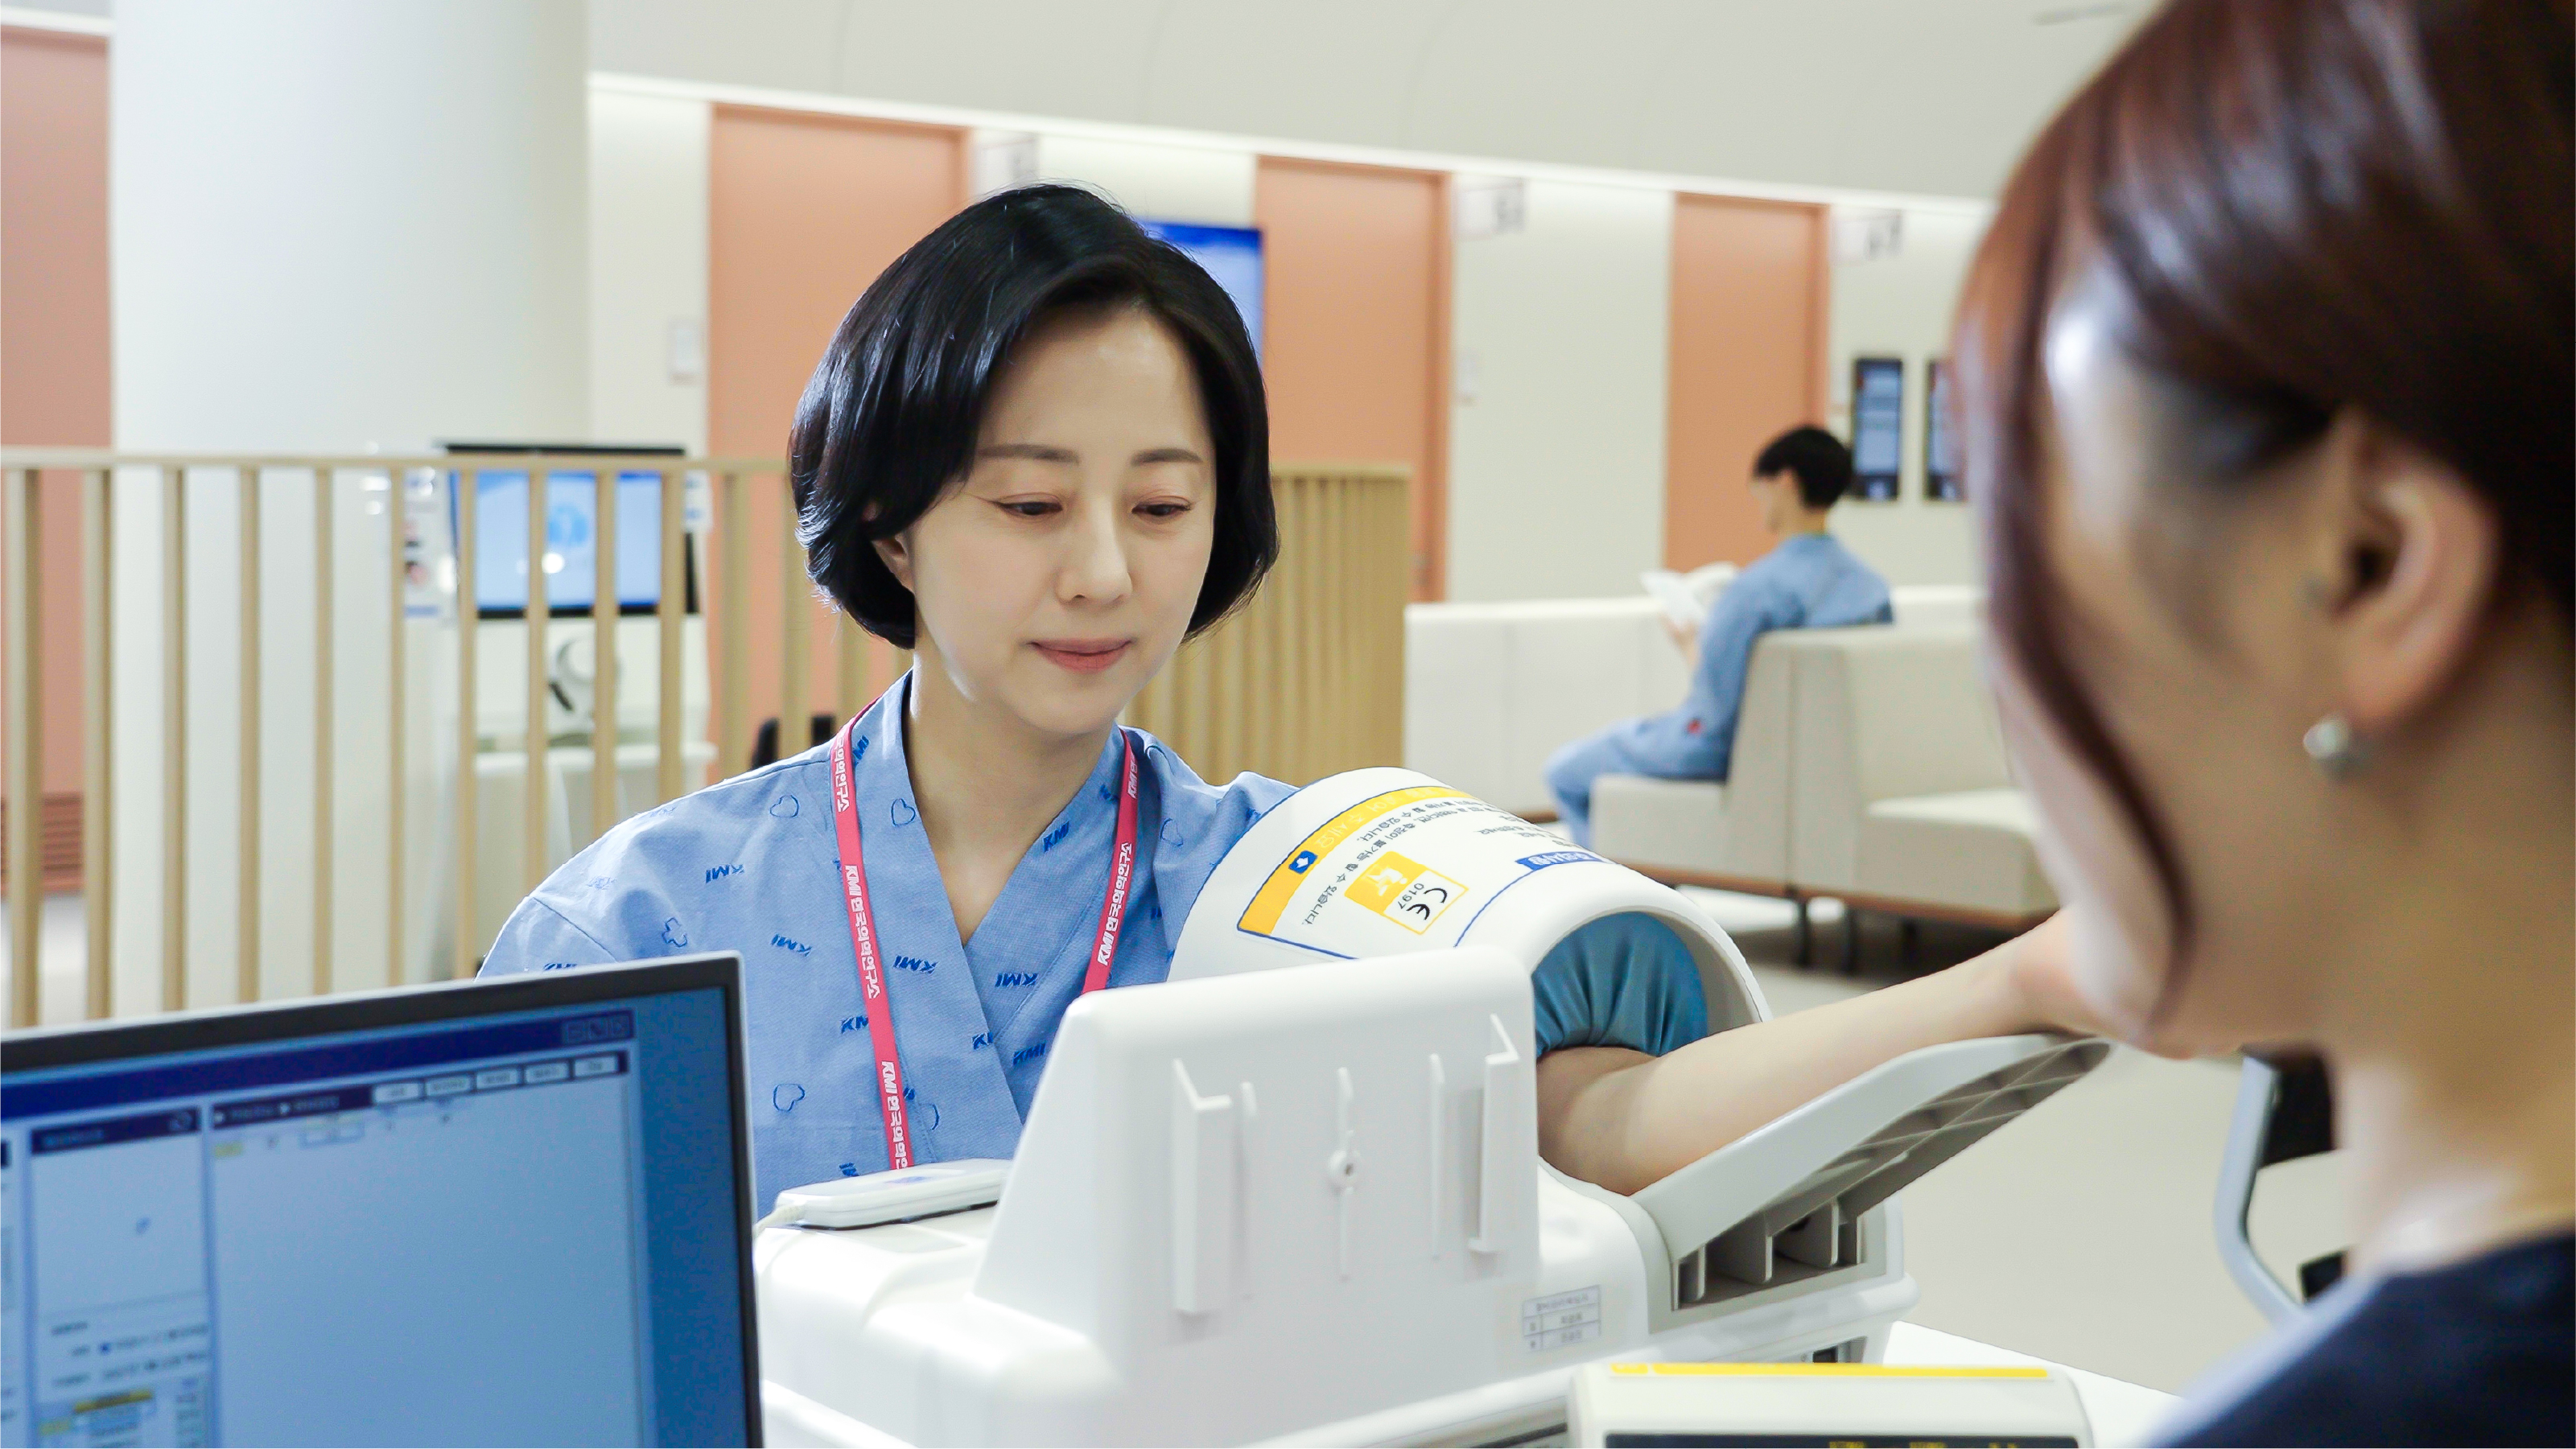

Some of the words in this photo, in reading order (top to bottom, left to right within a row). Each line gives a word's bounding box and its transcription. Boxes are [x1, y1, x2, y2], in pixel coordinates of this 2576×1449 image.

[835, 735, 850, 813] 국의학연구소
[1043, 821, 1070, 853] KMI
[1357, 817, 1401, 842] 있습니다.
[1384, 823, 1416, 840] 측정이
[1356, 839, 1387, 862] 불가능
[705, 864, 744, 884] KMI
[1336, 873, 1346, 883] 수
[1345, 862, 1359, 872] 할
[845, 865, 863, 897] KMI
[1097, 931, 1115, 966] KMI
[1106, 842, 1132, 932] 한국의학연구소
[1302, 884, 1337, 925] 있습니다.
[1397, 883, 1424, 910] 0197
[1406, 887, 1448, 921] CE
[770, 933, 812, 957] KMI
[851, 896, 881, 999] 한국의학연구소
[893, 955, 938, 975] KMI
[995, 973, 1039, 988] KMI
[841, 1015, 869, 1035] KM
[1012, 1041, 1046, 1066] KMI
[881, 1060, 898, 1094] KMI
